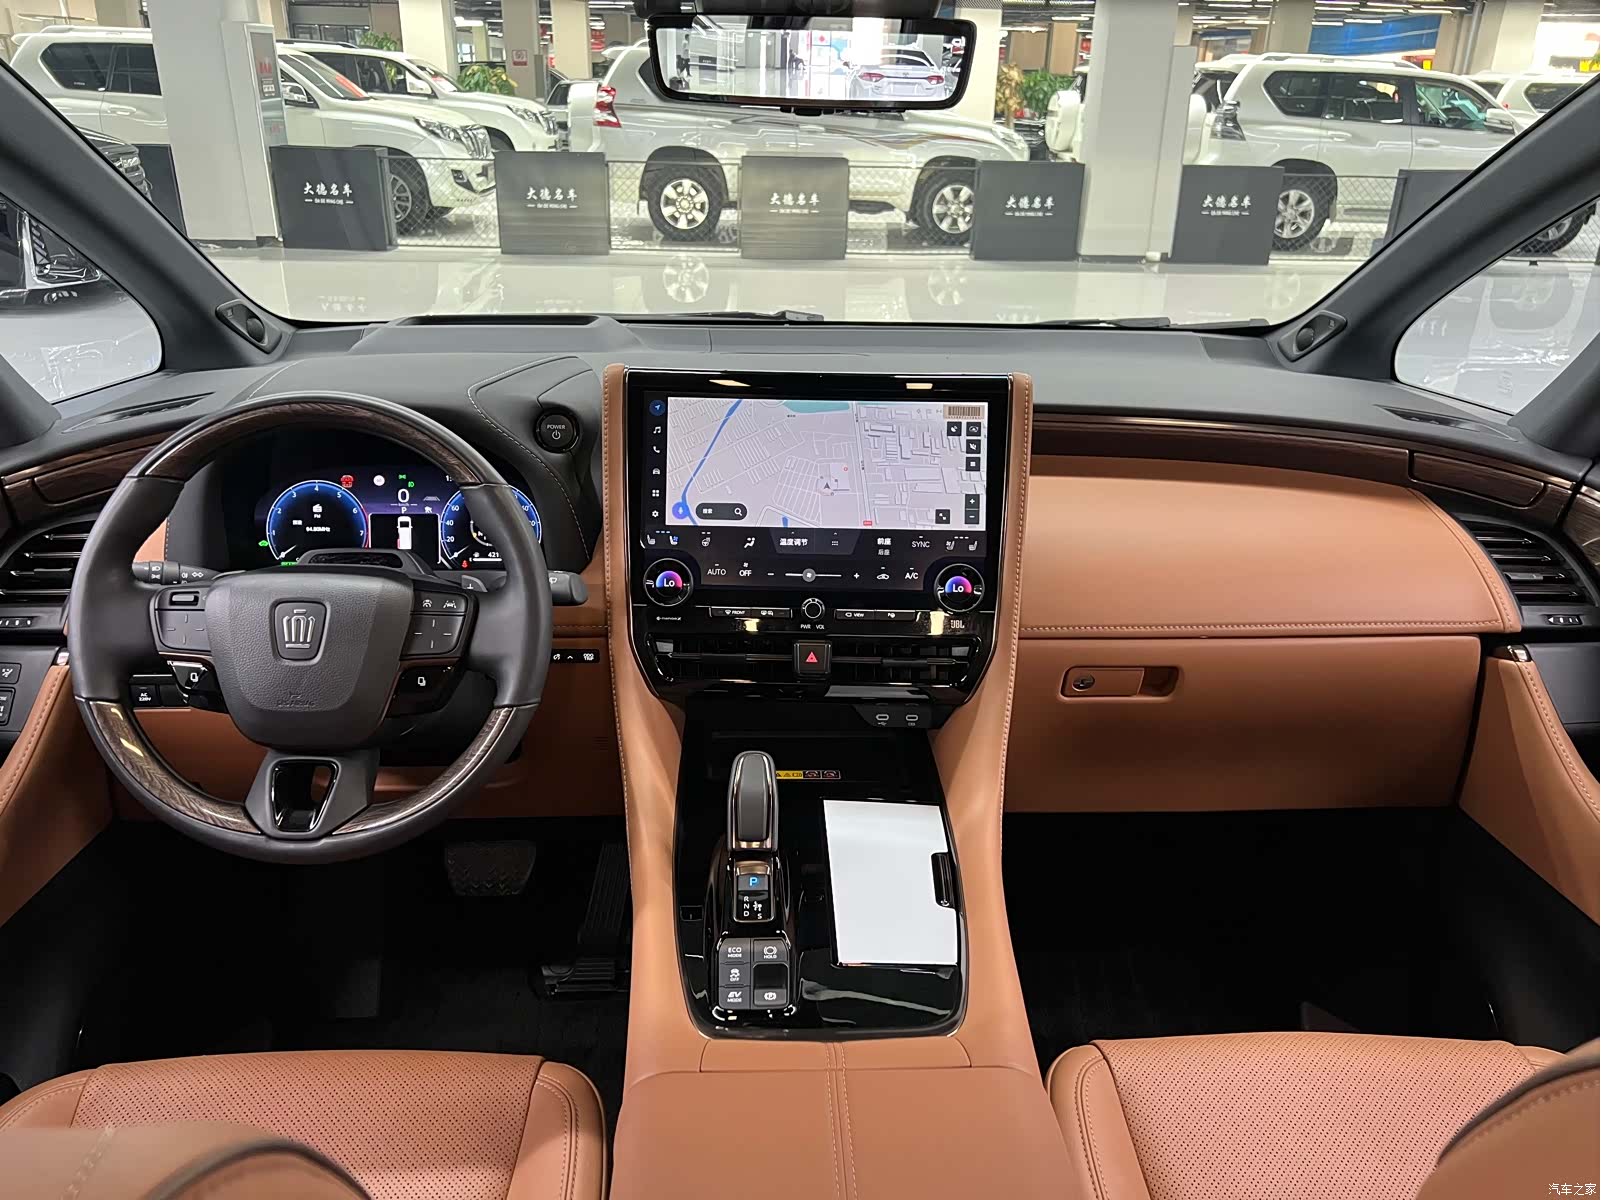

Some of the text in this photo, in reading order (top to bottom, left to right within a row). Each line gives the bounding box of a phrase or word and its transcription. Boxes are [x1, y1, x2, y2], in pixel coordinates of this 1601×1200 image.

[303, 181, 353, 197] 大德名车
[526, 186, 578, 201] 大德名车
[397, 488, 410, 503] 0
[401, 506, 407, 514] P
[451, 504, 460, 512] 60
[779, 537, 809, 547] 温度调节
[911, 540, 930, 549] SYNC
[707, 568, 726, 576] AUTO
[738, 569, 752, 577] OFF
[904, 571, 919, 580] A/C
[663, 578, 675, 588] Lo
[952, 583, 965, 593] Lo
[950, 619, 965, 629] JBL
[749, 876, 758, 887] P
